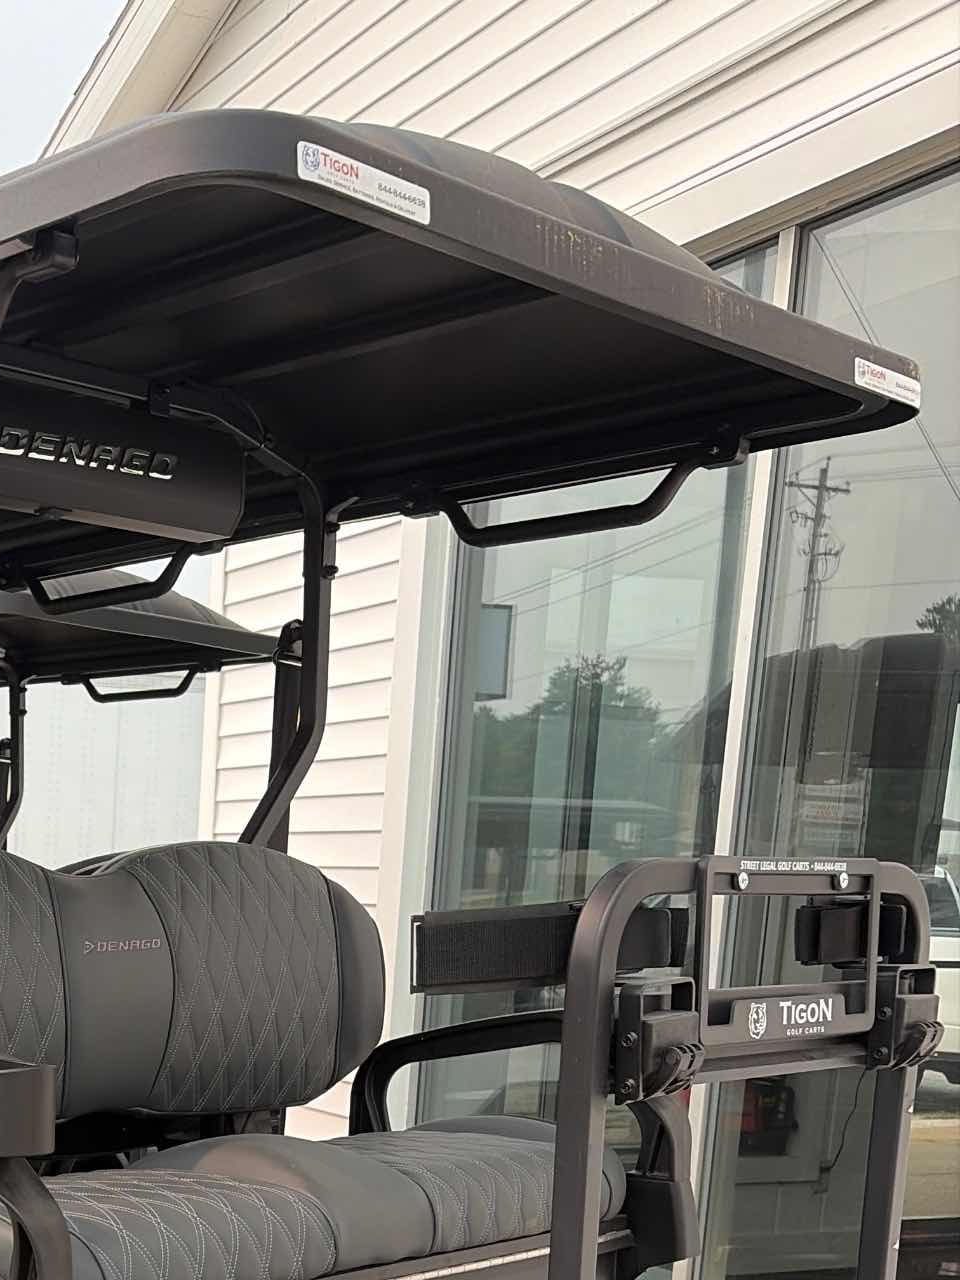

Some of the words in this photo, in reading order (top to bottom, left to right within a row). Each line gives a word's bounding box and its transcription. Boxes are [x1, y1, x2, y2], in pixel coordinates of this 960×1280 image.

[320, 152, 359, 180] TIGON
[740, 860, 759, 870] STREET
[760, 861, 776, 871] LEGAL
[777, 861, 792, 871] GOLF
[792, 861, 809, 871] CARTS
[97, 939, 161, 952] DENAGO
[779, 998, 833, 1025] TIGON
[786, 1027, 803, 1036] GOLF
[804, 1026, 825, 1034] CARTS
